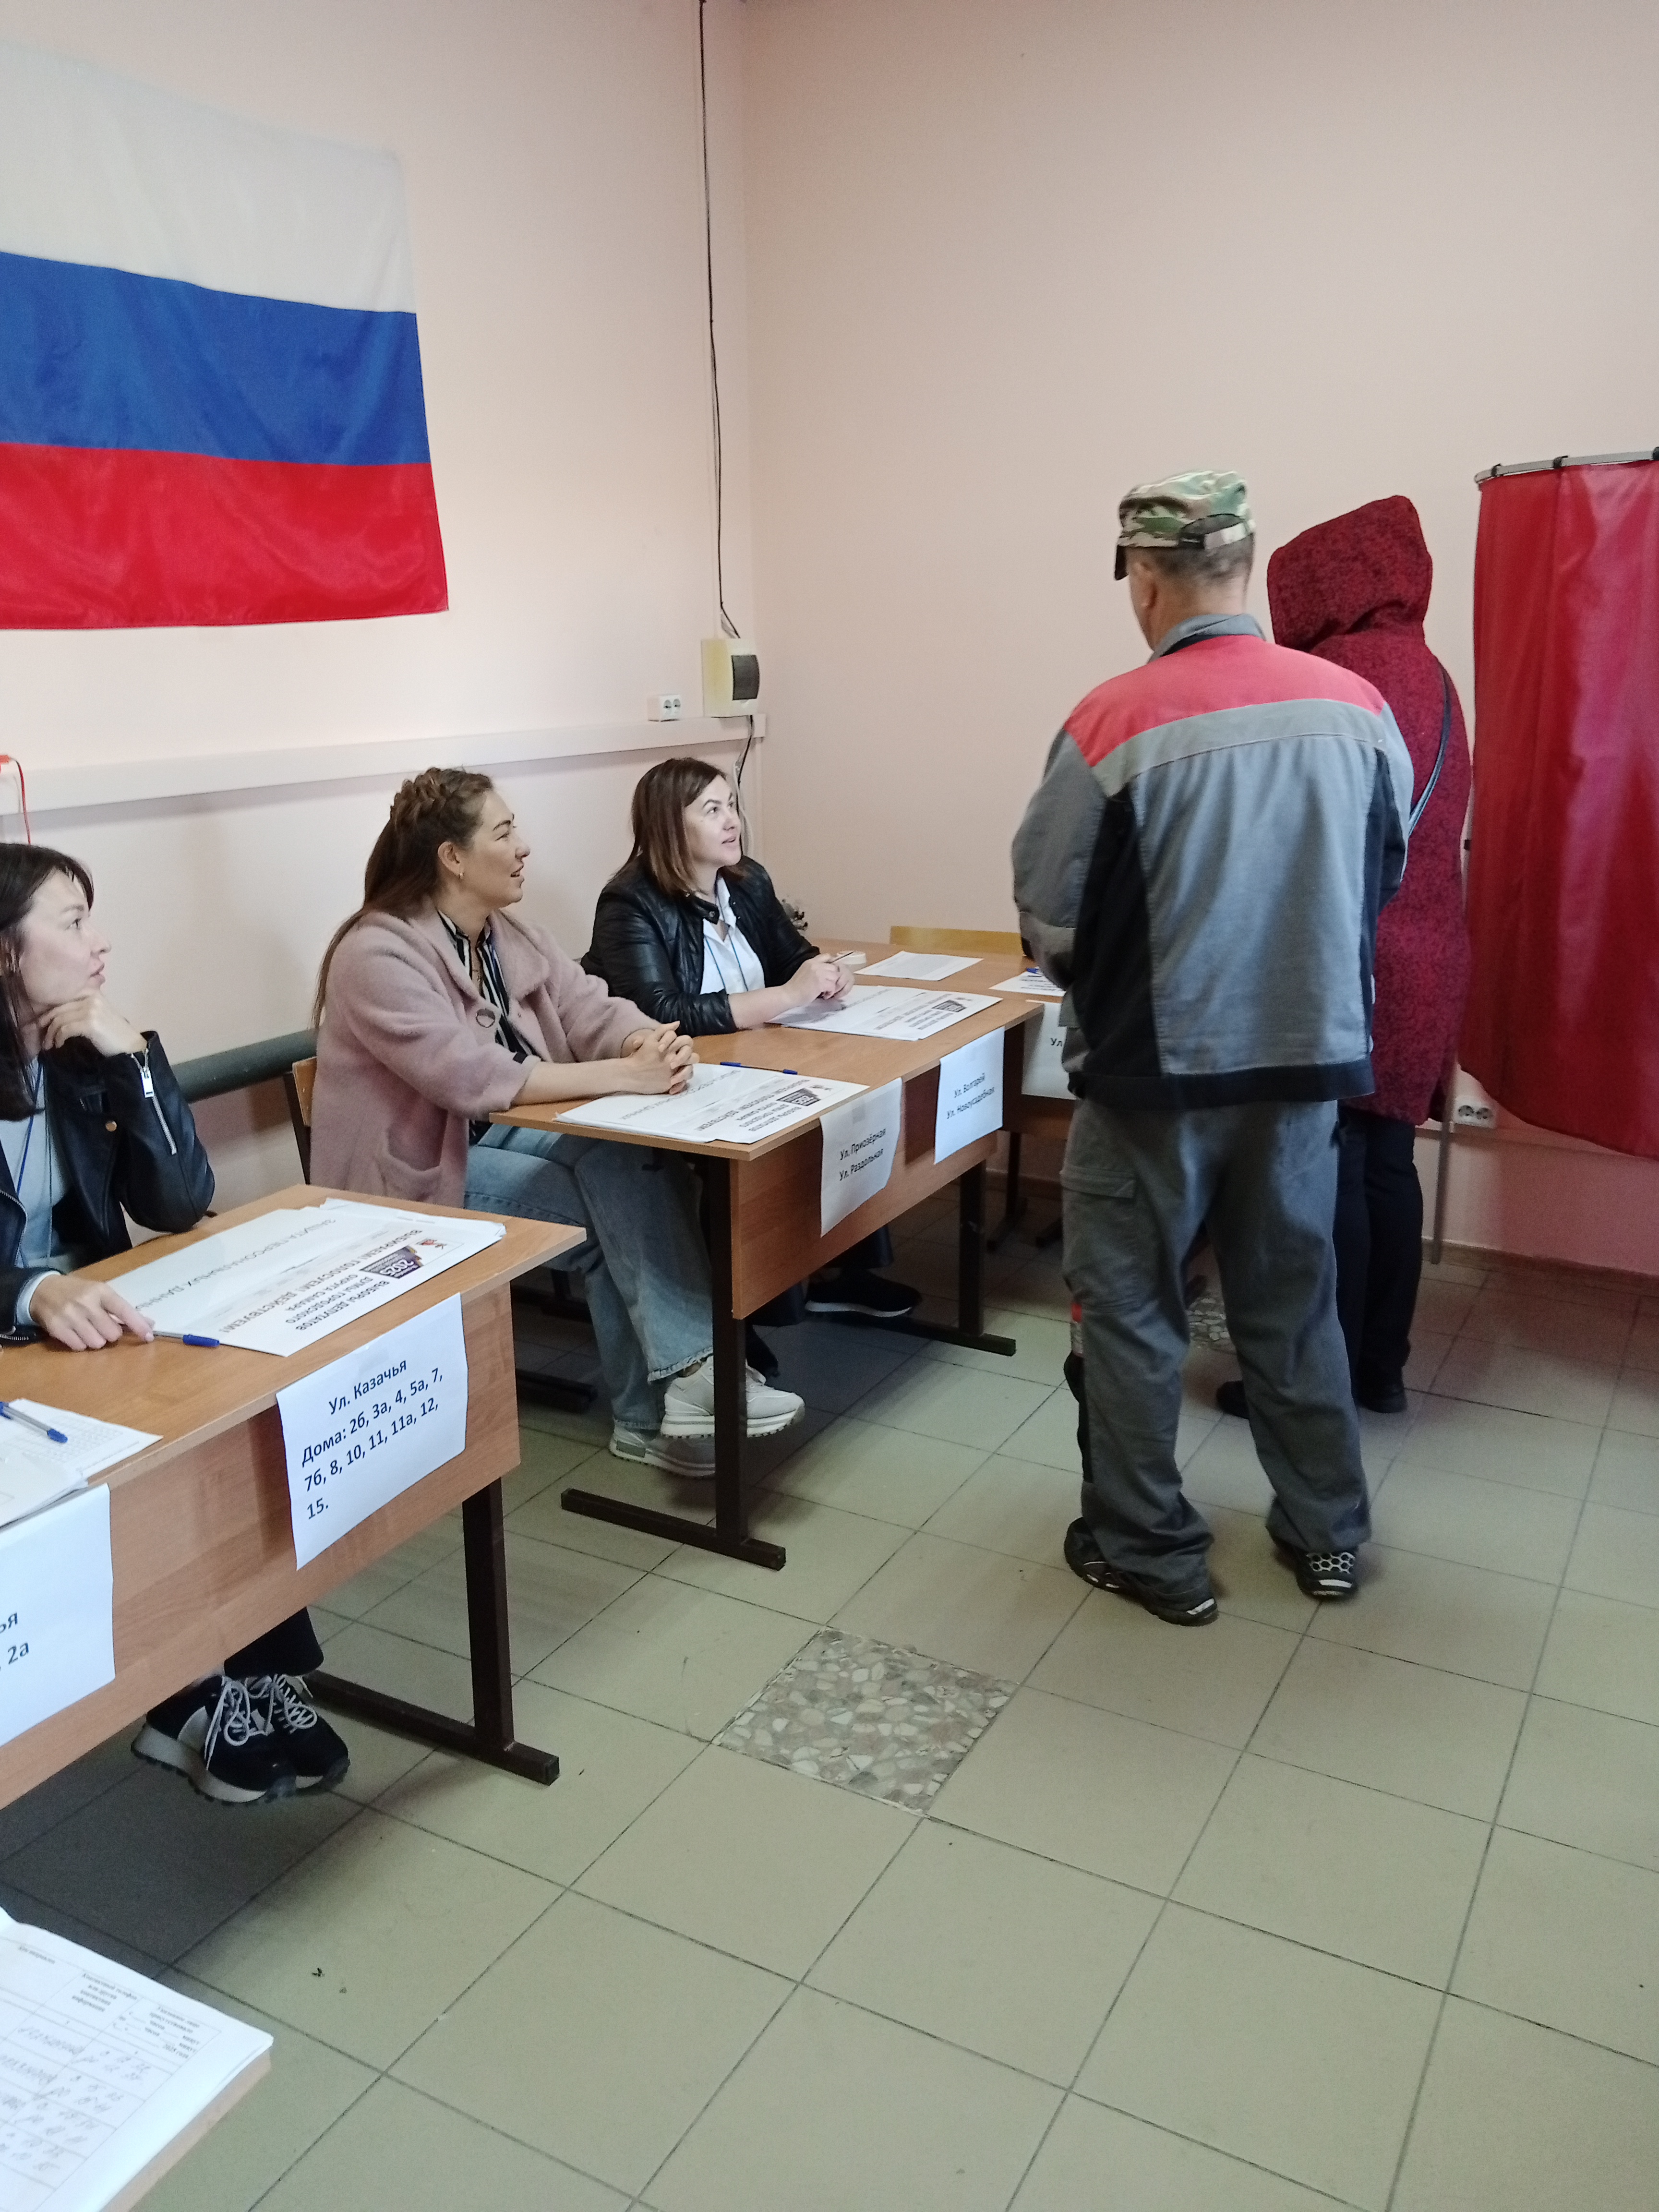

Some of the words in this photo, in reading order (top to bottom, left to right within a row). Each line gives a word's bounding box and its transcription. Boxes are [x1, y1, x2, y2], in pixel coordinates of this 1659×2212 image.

[840, 1149, 850, 1160] Ул.
[851, 1128, 886, 1154] Приозёрная
[839, 1169, 850, 1181] Ул.
[379, 1259, 414, 1277] 2025
[135, 1285, 184, 1311] ДАННЫ
[286, 1291, 346, 1324] ГОРОДСКОГО
[348, 1280, 390, 1304] ВЫБОРЫ
[219, 1290, 297, 1333] ДЕЙСТВУЕМ!
[295, 1301, 349, 1332] ДЕПУТАТОВ
[329, 1395, 350, 1415] Ул.
[353, 1360, 407, 1400] Казачья
[302, 1428, 347, 1467] Дома:
[349, 1412, 369, 1434] 2б,
[372, 1401, 392, 1420] 3а,
[395, 1389, 407, 1405] 4,
[410, 1380, 428, 1397] 5а,
[432, 1368, 443, 1383] 7,
[304, 1468, 326, 1492] 7б,
[330, 1460, 343, 1475] 8,
[346, 1444, 365, 1466] 10,
[369, 1430, 387, 1451] 11,
[391, 1414, 417, 1436] 11а,
[421, 1397, 438, 1418] 12,
[307, 1497, 329, 1520] 15.
[8, 1642, 29, 1665] 2а
